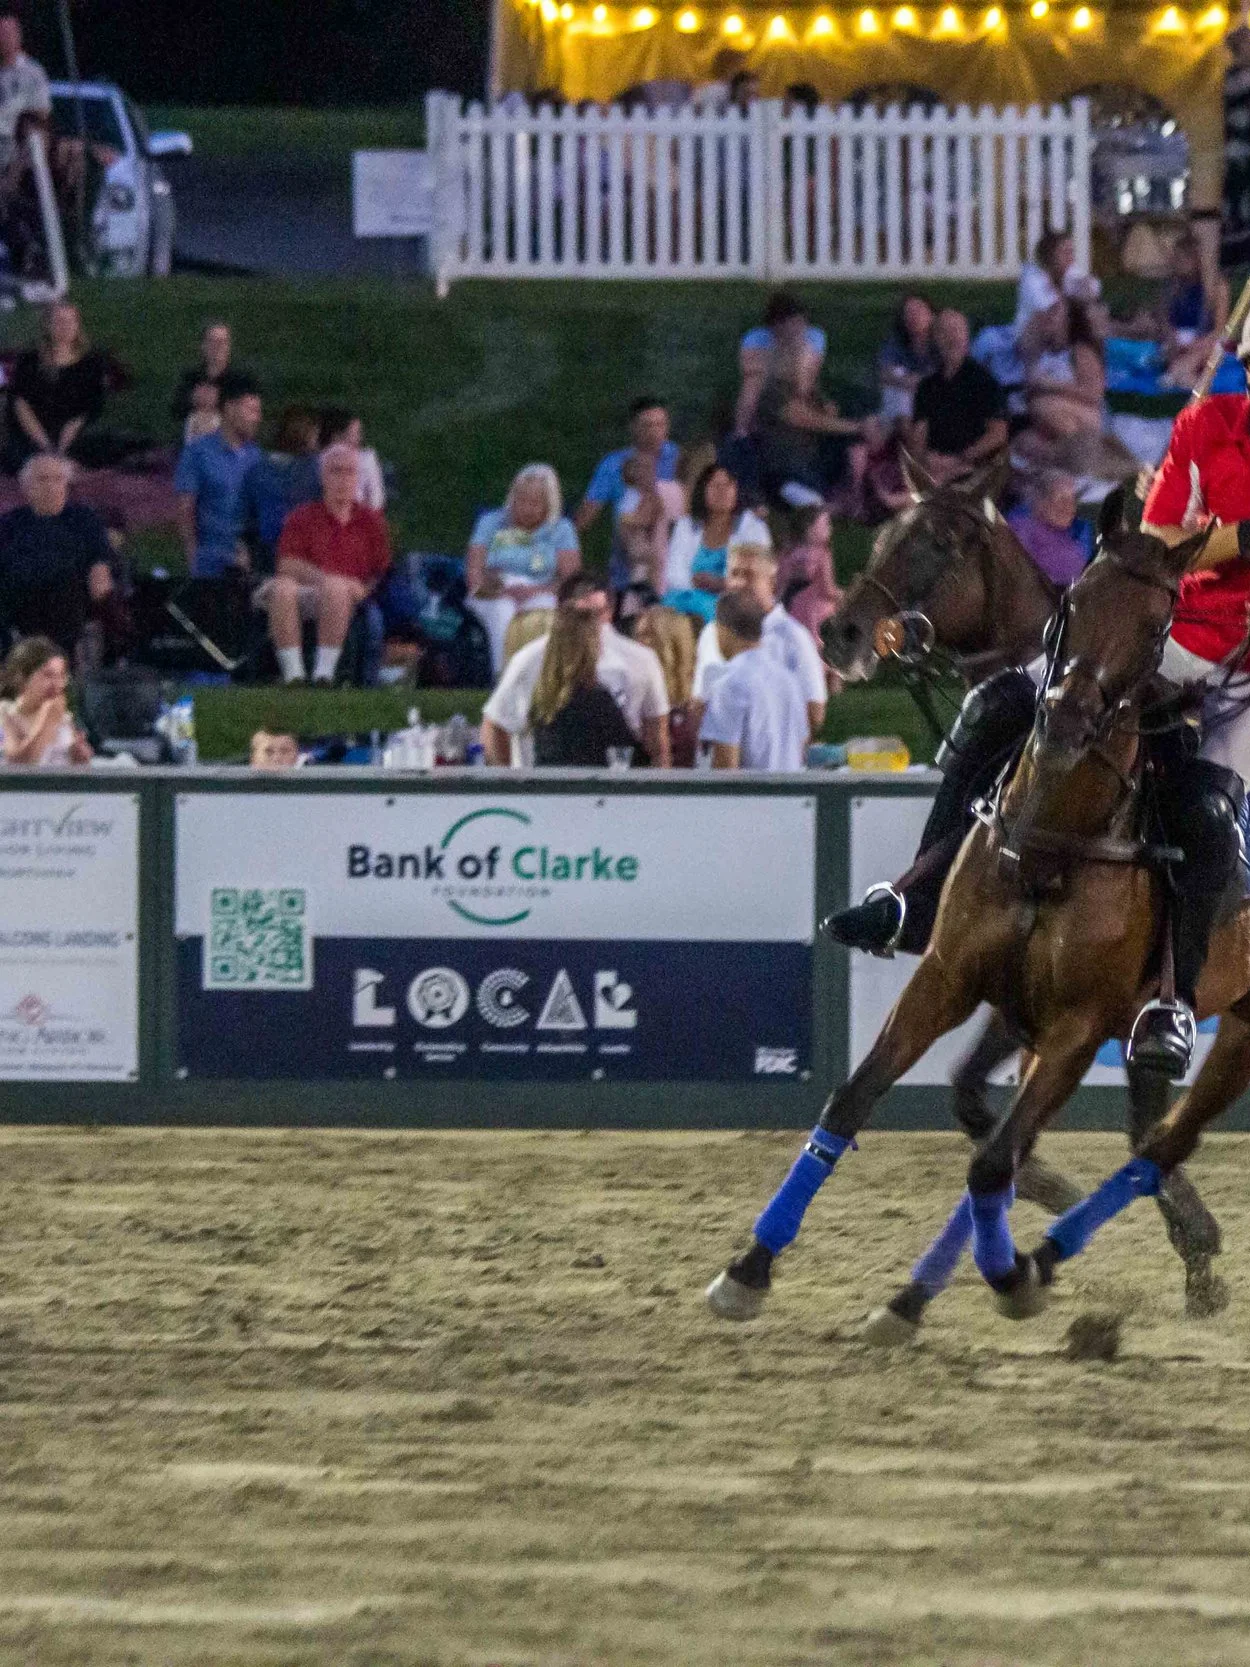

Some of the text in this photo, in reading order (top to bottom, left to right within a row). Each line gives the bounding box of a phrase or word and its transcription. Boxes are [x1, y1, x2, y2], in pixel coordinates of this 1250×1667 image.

[348, 845, 640, 882] Bank of Clarke
